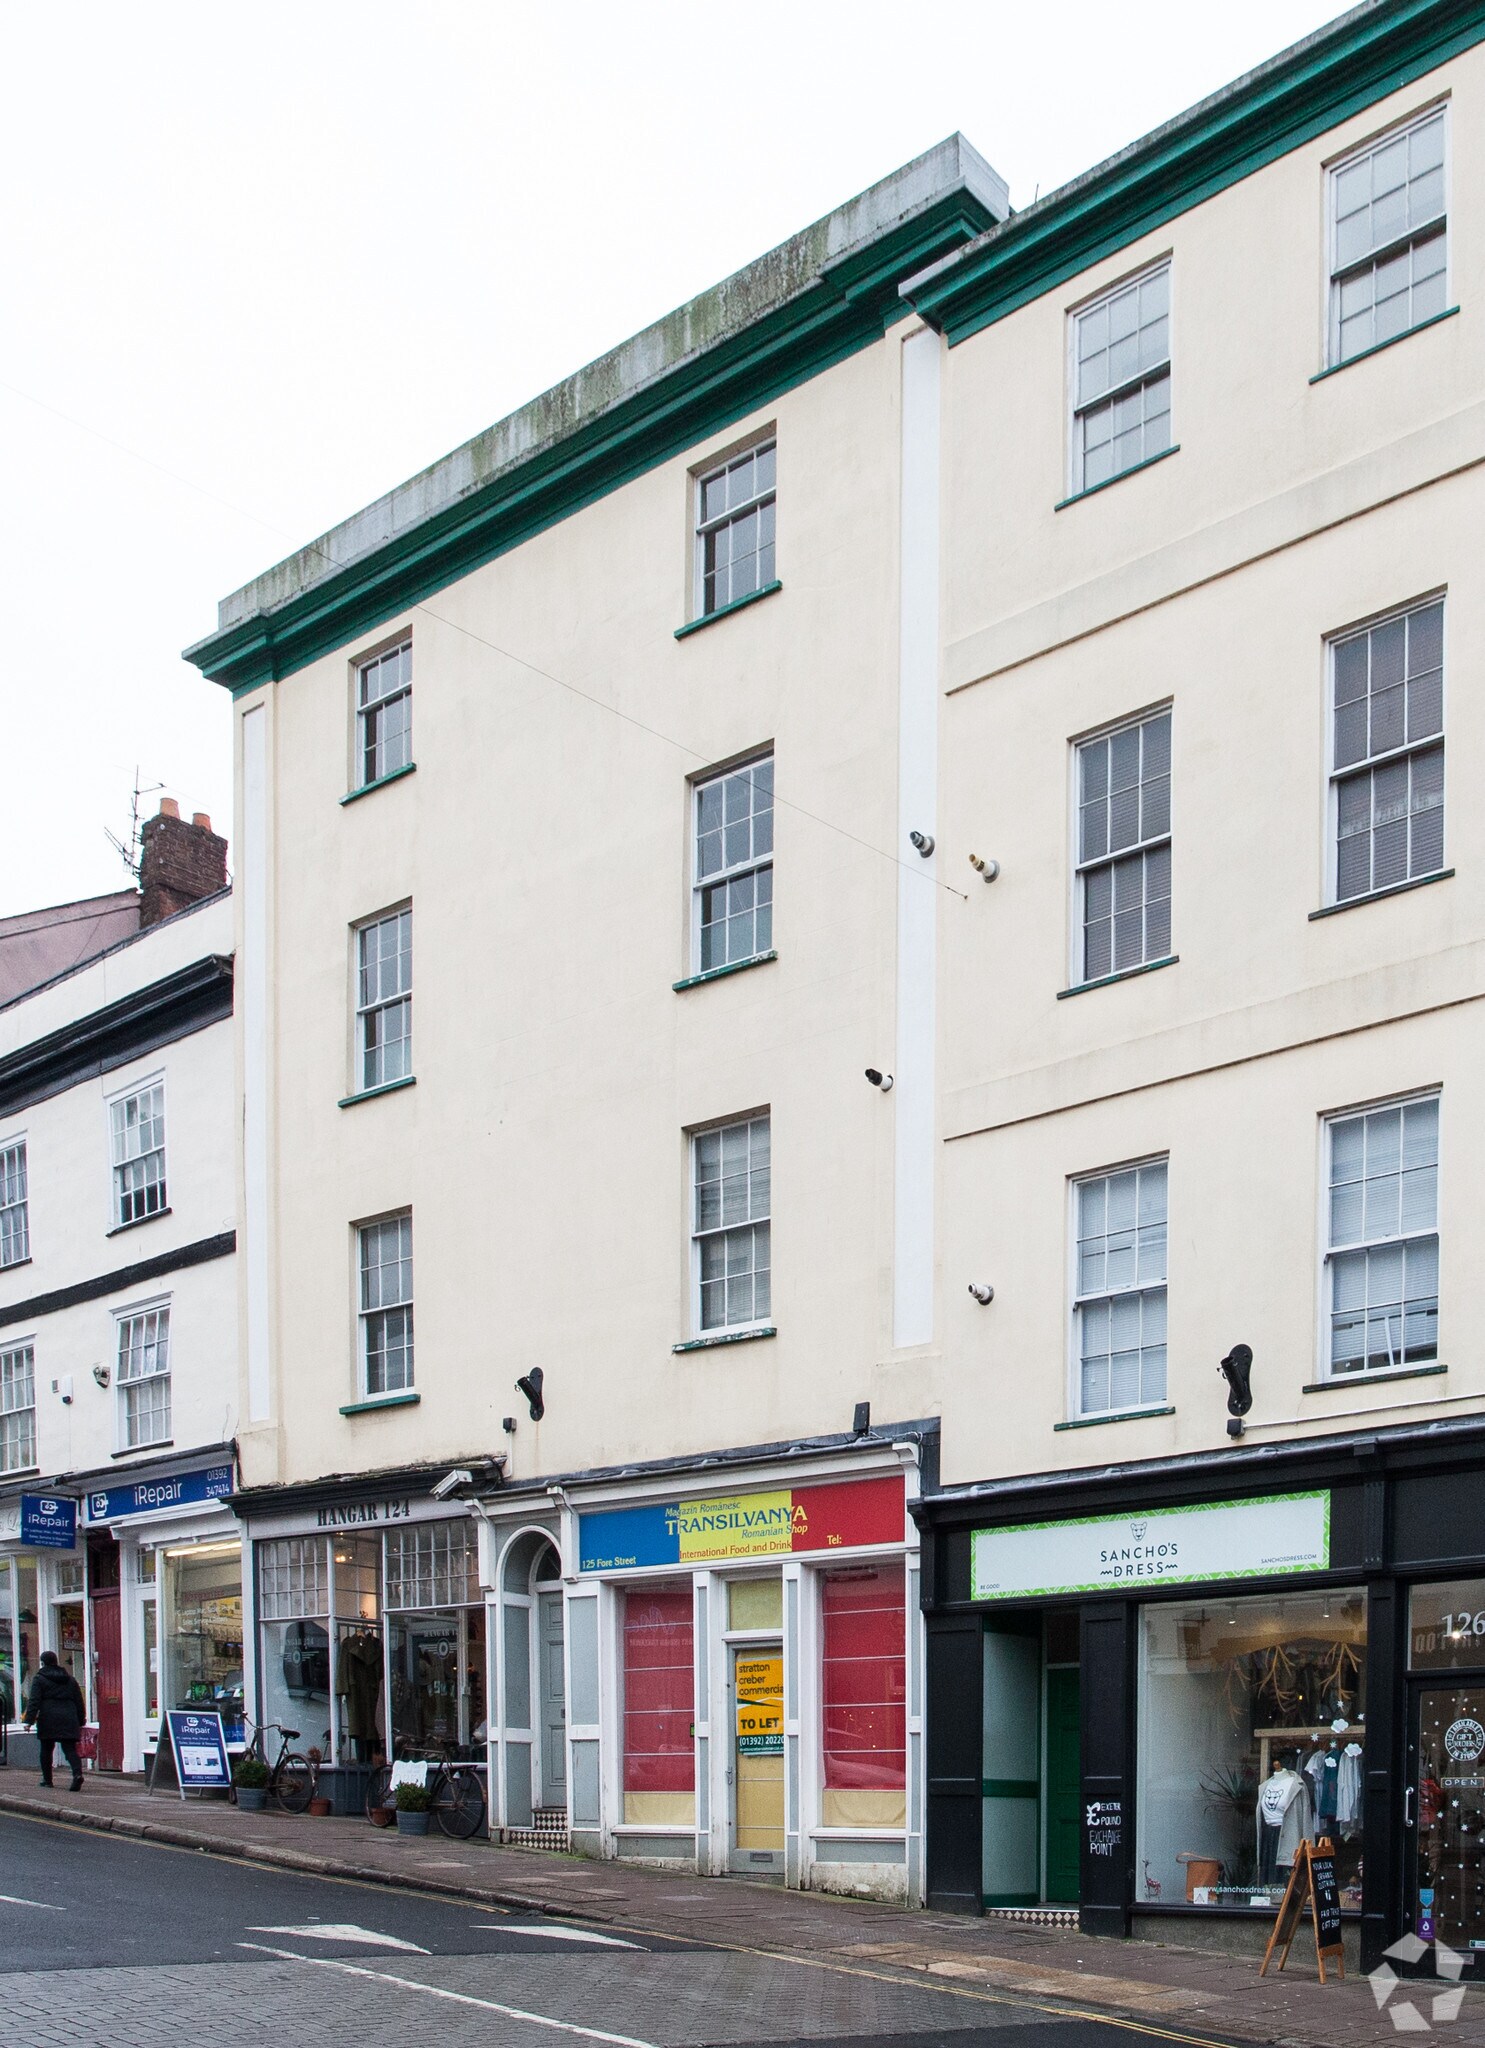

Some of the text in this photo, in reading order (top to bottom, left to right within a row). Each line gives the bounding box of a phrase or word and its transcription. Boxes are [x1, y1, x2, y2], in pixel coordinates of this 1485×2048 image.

[206, 1468, 228, 1481] 01392
[134, 1479, 183, 1506] iRepair
[206, 1483, 230, 1498] 347414
[317, 1499, 410, 1527] HANGAR 124
[664, 1504, 698, 1518] Magazin
[28, 1513, 70, 1527] iRepair
[664, 1505, 808, 1536] TRANSILVANYA
[741, 1524, 808, 1539] Romanian Shop
[826, 1534, 842, 1545] Tel:
[679, 1540, 792, 1560] International Food and Drink
[1100, 1542, 1178, 1562] SANCHO'S
[582, 1555, 637, 1570] 125 Fore Street
[1260, 1553, 1317, 1564] SANCHOSDRESS.COM
[1113, 1561, 1164, 1577] DRESS
[1441, 1610, 1485, 1637] 126
[739, 1663, 770, 1674] stratton
[739, 1674, 766, 1685] creber
[739, 1684, 784, 1696] commercia
[181, 1725, 210, 1735] iRepair
[741, 1717, 780, 1729] TO LET
[739, 1735, 784, 1747] (01392) 20220
[1456, 1733, 1473, 1741] GIFT
[1100, 1815, 1121, 1826] POUND
[1089, 1829, 1122, 1843] EXCHANGE
[1090, 1842, 1113, 1857] POINT
[1199, 1885, 1288, 1895] w.sanchosdress.com
